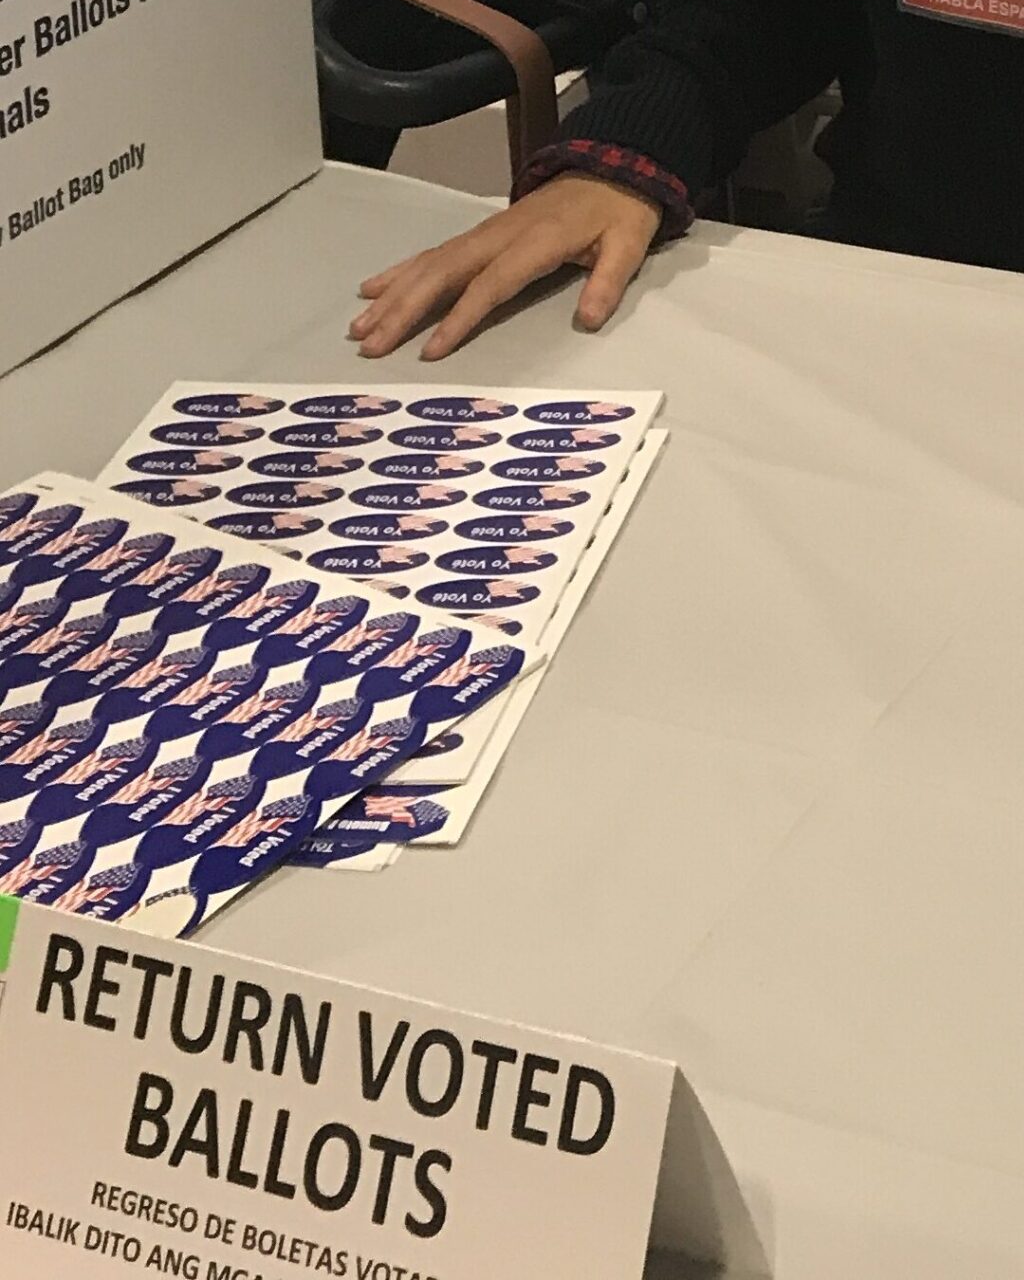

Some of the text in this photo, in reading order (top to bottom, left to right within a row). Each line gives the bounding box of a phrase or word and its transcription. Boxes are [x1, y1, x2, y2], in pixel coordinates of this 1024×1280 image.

[9, 188, 65, 241] Ballot
[69, 169, 104, 204] Bag
[109, 142, 145, 181] only
[226, 406, 241, 414] Yo
[340, 406, 358, 414] Yo
[457, 409, 476, 418] Yo
[574, 412, 592, 420] Yo
[202, 433, 220, 442] Yo
[321, 434, 339, 443] Yo
[440, 437, 458, 446] Yo
[559, 439, 578, 448] Yo
[179, 462, 197, 471] Yo
[300, 464, 319, 472] Yo
[421, 466, 440, 475] Yo
[544, 468, 562, 477] Yo
[156, 492, 175, 502] Yo
[279, 494, 298, 503] Yo
[403, 496, 421, 505] Yo
[526, 498, 545, 507] Yo
[257, 525, 277, 534] Yo
[383, 527, 402, 537] Yo
[509, 528, 529, 537] Yo
[100, 561, 141, 584] Voted
[363, 558, 383, 569] Yo
[491, 560, 511, 570] Yo
[147, 575, 188, 599] Voted
[472, 593, 492, 604] Yo
[196, 592, 237, 616] Voted
[246, 608, 287, 632] Voted
[296, 624, 337, 649] Voted
[348, 641, 388, 665] Voted
[400, 658, 439, 683] Voted
[138, 677, 182, 703] Voted
[453, 677, 493, 703] Voted
[190, 695, 233, 720] Voted
[242, 712, 285, 739] Voted
[295, 730, 339, 757] Voted
[23, 753, 70, 782] Voted
[351, 750, 394, 777] Voted
[75, 772, 122, 801] Voted
[128, 791, 175, 822] Voted
[183, 813, 230, 843] Voted
[239, 835, 285, 867] Voted
[36, 933, 616, 1156] RETURN VOTED
[124, 1071, 453, 1238] BALLOTS
[6, 1201, 81, 1246] IBALIK
[83, 1224, 142, 1263] DITO
[145, 1245, 200, 1280] ANG
[91, 1181, 198, 1233] REGRESO
[203, 1213, 233, 1244] DE
[242, 1223, 348, 1277] BOLETAS
